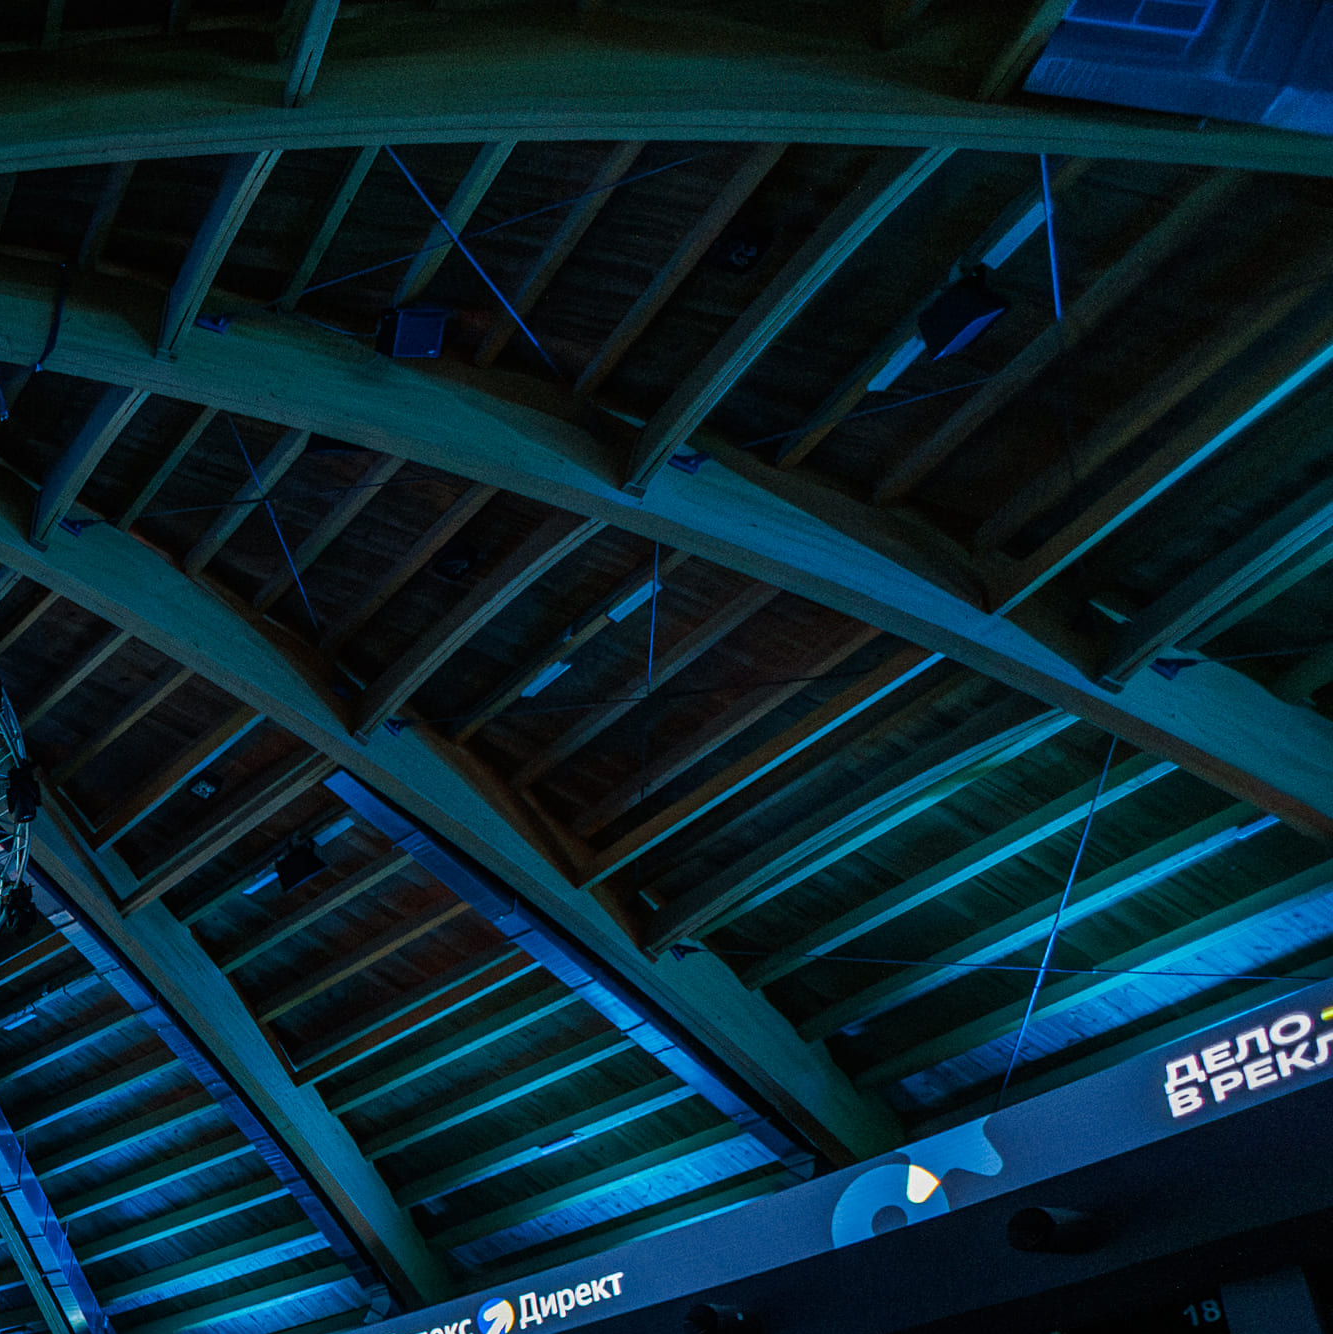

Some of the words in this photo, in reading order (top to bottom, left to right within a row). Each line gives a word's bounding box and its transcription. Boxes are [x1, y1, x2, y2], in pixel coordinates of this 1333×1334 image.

[1164, 1012, 1314, 1094] ДЕЛО
[1167, 1086, 1205, 1119] В
[519, 1271, 625, 1330] Директ
[1183, 1299, 1222, 1327] 18
